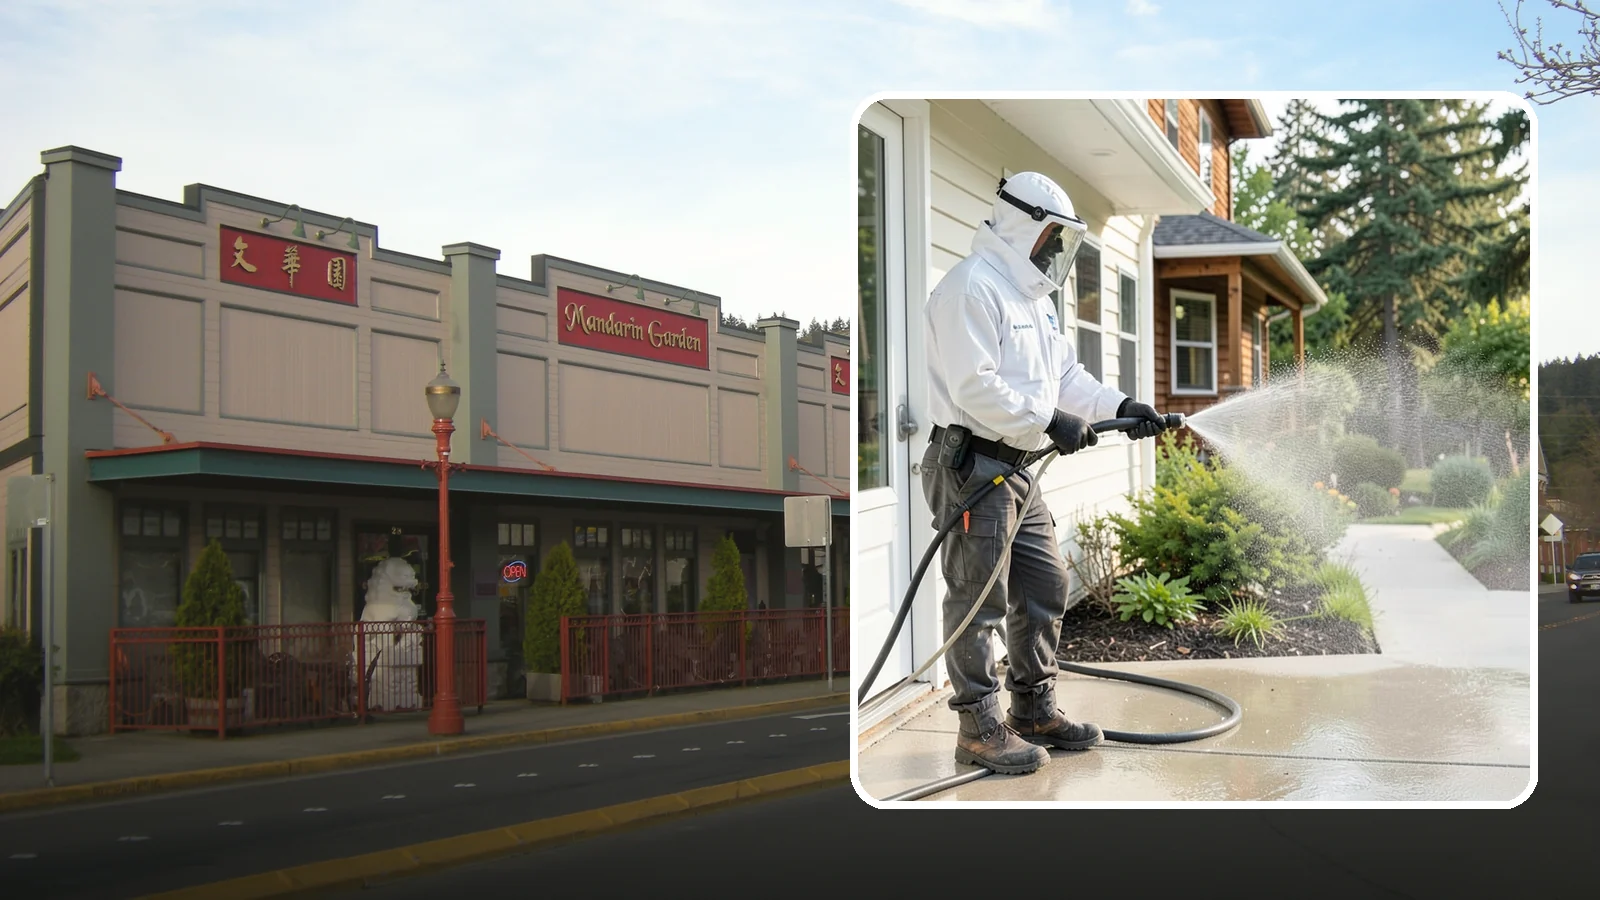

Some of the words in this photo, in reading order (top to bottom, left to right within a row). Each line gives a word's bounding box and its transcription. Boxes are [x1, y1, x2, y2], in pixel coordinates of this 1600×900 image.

[564, 302, 644, 341] Mandarin
[647, 320, 702, 352] Garden
[503, 565, 527, 578] OPEN
